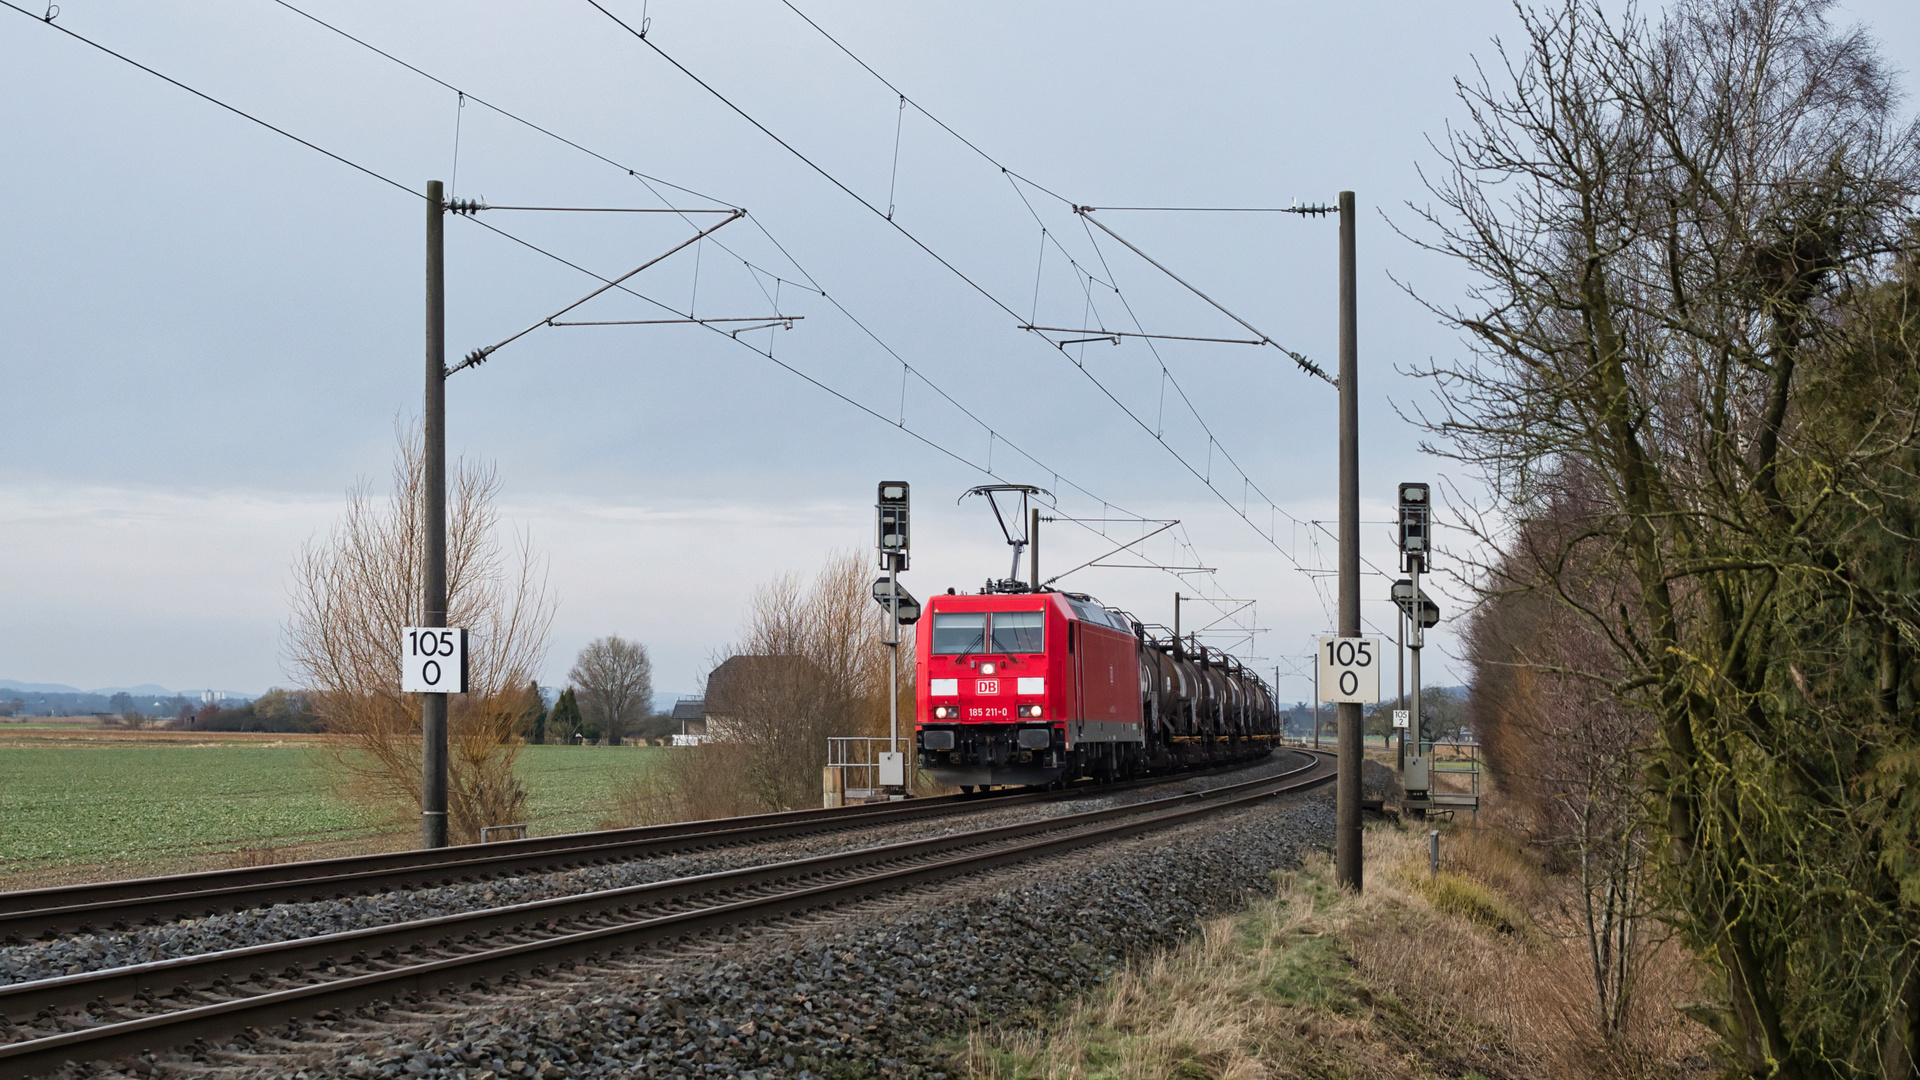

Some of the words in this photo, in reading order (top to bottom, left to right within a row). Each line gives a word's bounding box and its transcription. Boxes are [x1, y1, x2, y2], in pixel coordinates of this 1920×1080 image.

[409, 631, 454, 657] 105
[1326, 641, 1372, 667] 105
[422, 660, 441, 686] 0
[1339, 670, 1359, 696] 0
[979, 682, 997, 693] DB
[969, 708, 983, 717] 185
[985, 708, 1008, 717] 211-0
[1398, 718, 1404, 726] 2
